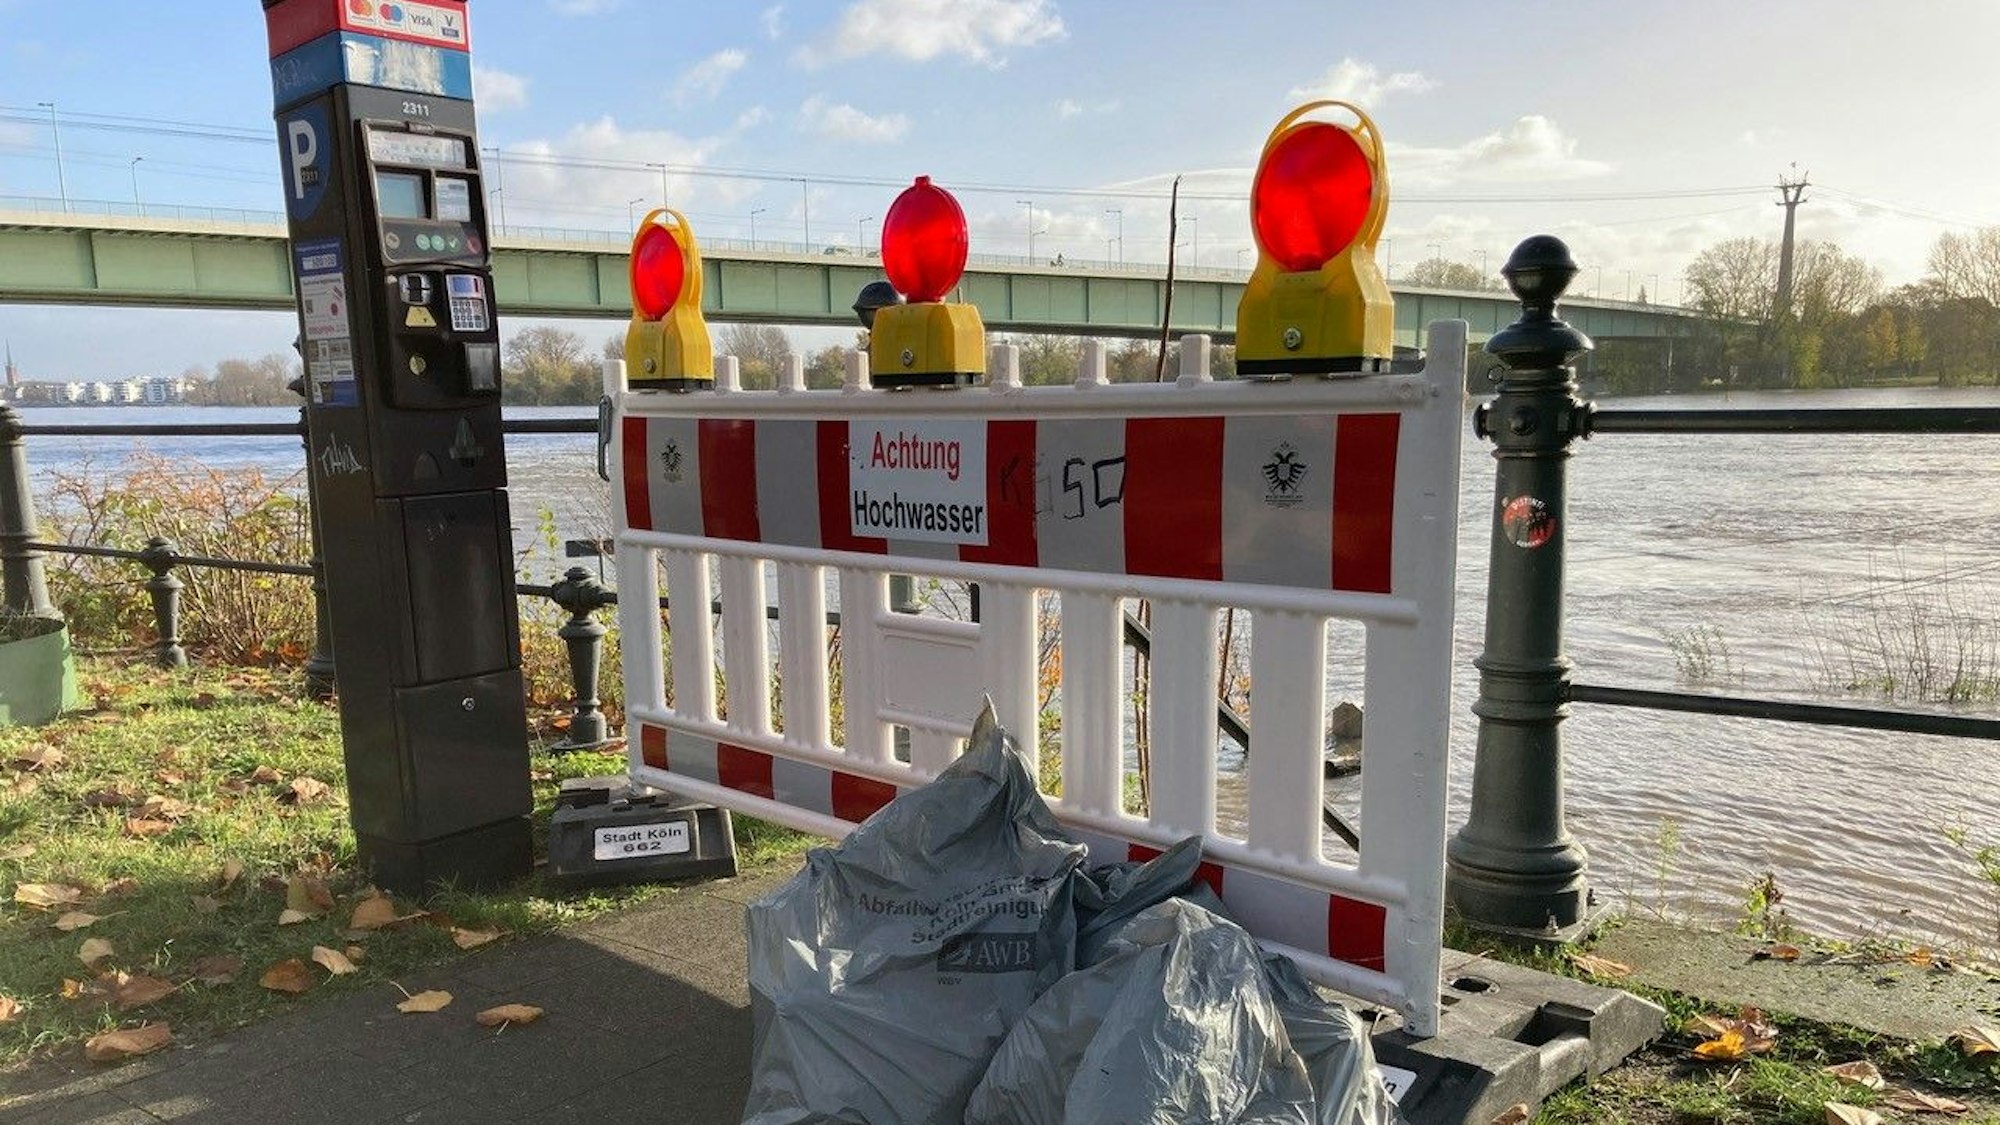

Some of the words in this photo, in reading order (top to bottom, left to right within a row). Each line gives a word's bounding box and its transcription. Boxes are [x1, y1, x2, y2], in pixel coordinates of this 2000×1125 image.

[411, 14, 433, 27] VISA
[402, 101, 430, 117] 2311
[288, 119, 317, 199] P
[871, 431, 961, 481] Achtung
[854, 490, 984, 533] Hochwasser
[602, 830, 642, 844] Stadt
[647, 827, 682, 840] Köln
[623, 841, 662, 853] 662
[974, 939, 1031, 966] AWB
